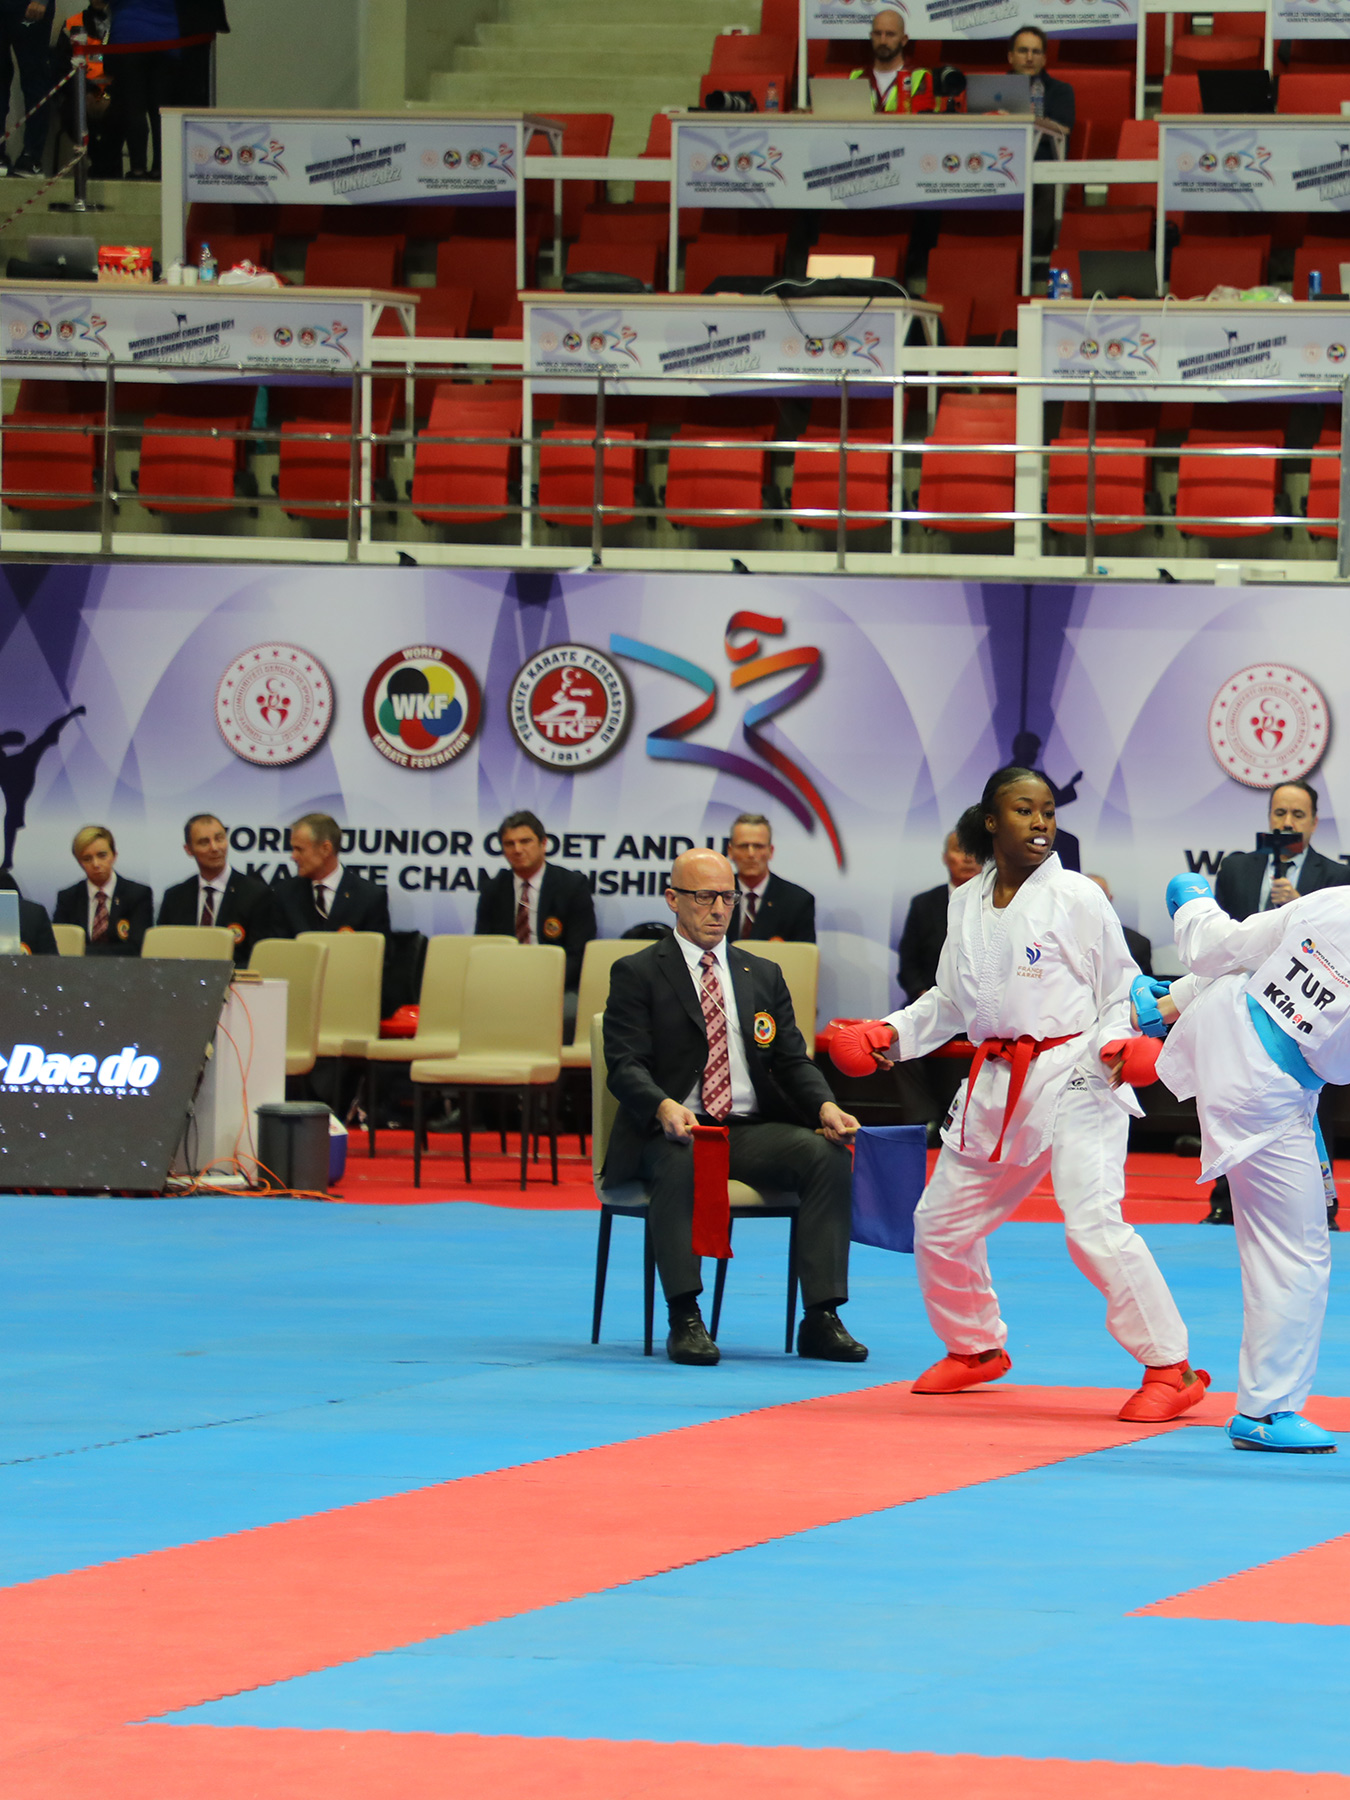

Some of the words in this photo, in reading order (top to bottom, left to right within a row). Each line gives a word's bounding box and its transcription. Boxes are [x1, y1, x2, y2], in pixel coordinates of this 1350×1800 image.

[402, 647, 443, 660] WORLD
[527, 651, 577, 680] KARATE
[391, 693, 449, 720] WKF
[372, 733, 409, 767] KARATE
[410, 731, 470, 768] FEDERATION
[340, 828, 473, 856] JUNIOR
[613, 834, 695, 861] AND
[1018, 965, 1044, 974] FRANCE
[1285, 956, 1336, 1011] TUR
[0, 1084, 150, 1096] INTERNATIONAL
